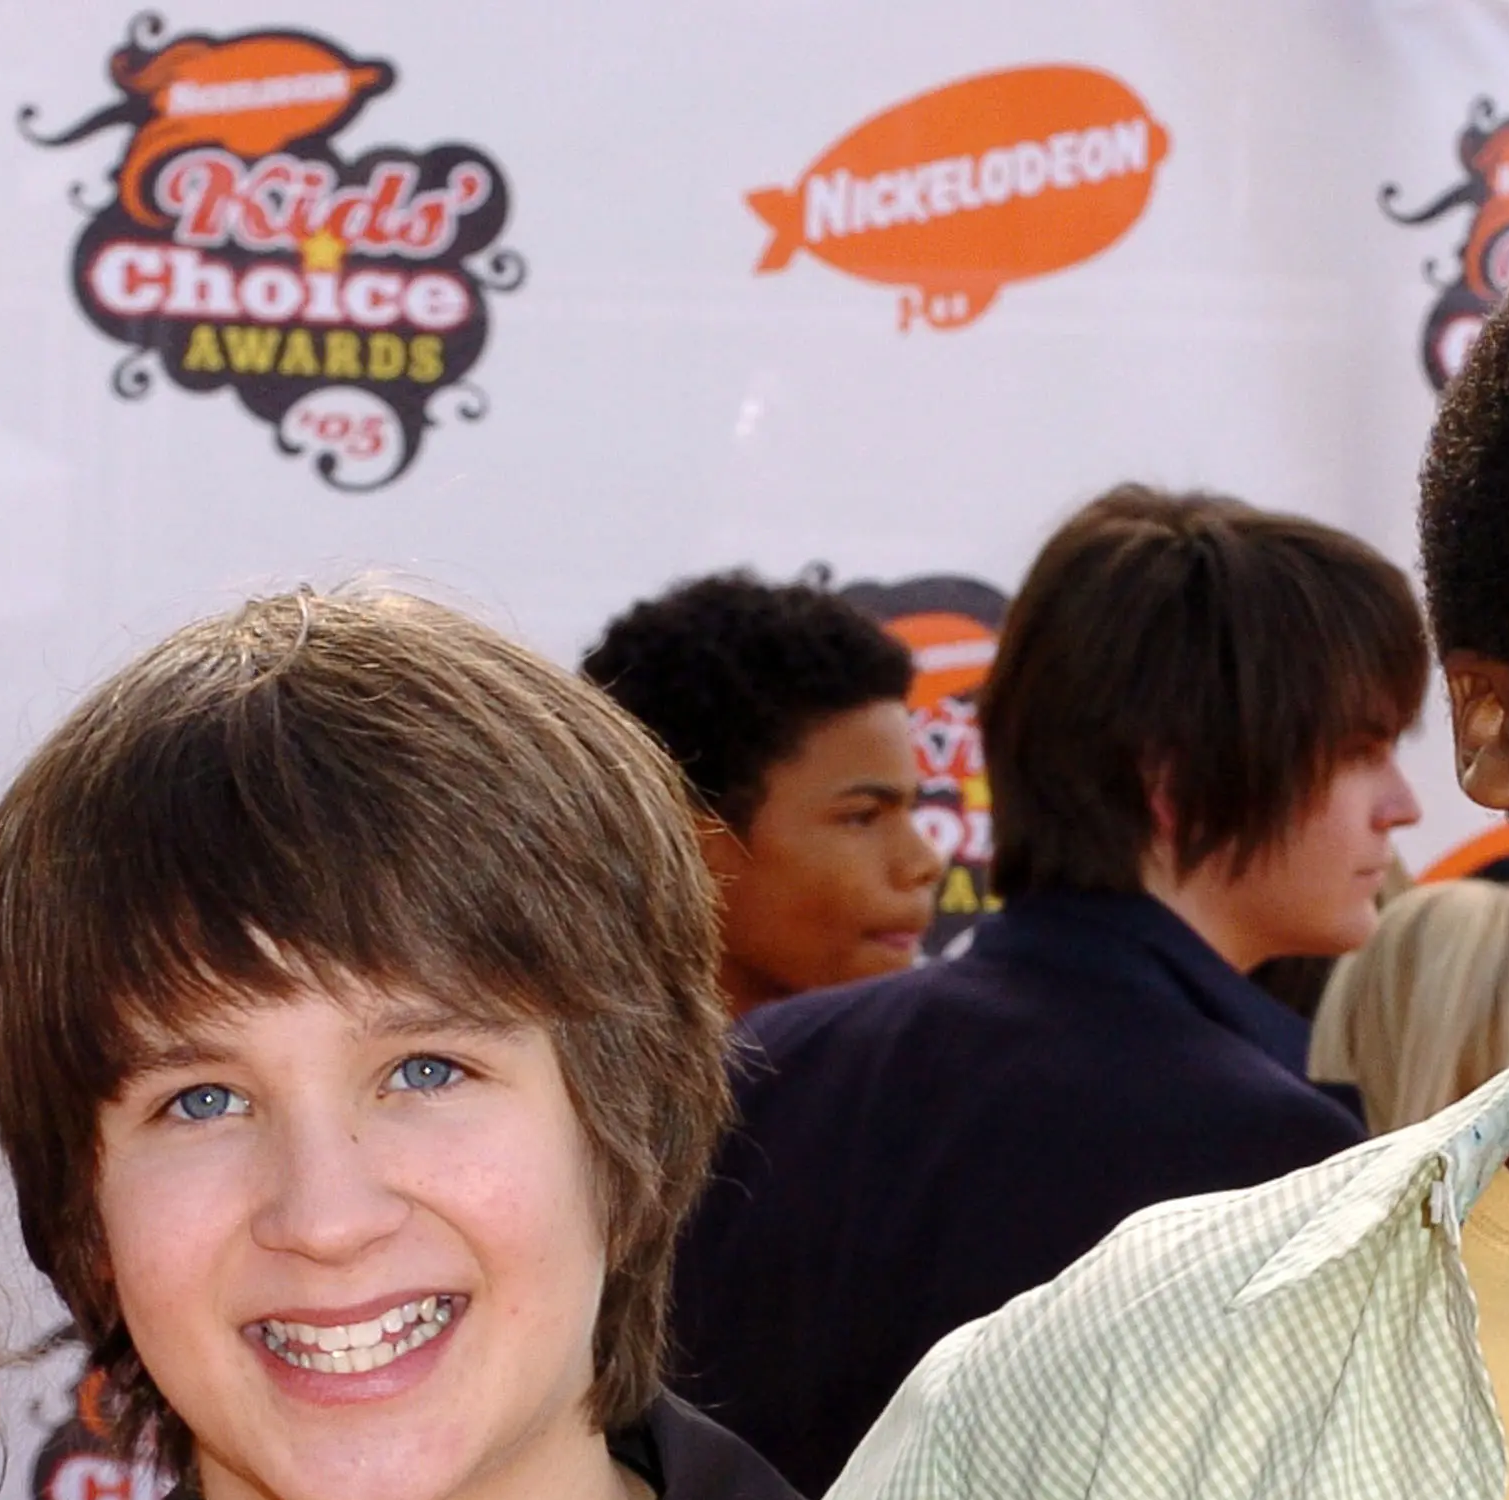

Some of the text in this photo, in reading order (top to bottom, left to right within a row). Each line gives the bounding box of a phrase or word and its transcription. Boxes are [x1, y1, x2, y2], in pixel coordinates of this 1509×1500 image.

[158, 152, 487, 256] Kids'
[804, 119, 1150, 241] NICKELODEON
[93, 243, 469, 328] Choice
[184, 325, 446, 382] AWARDS
